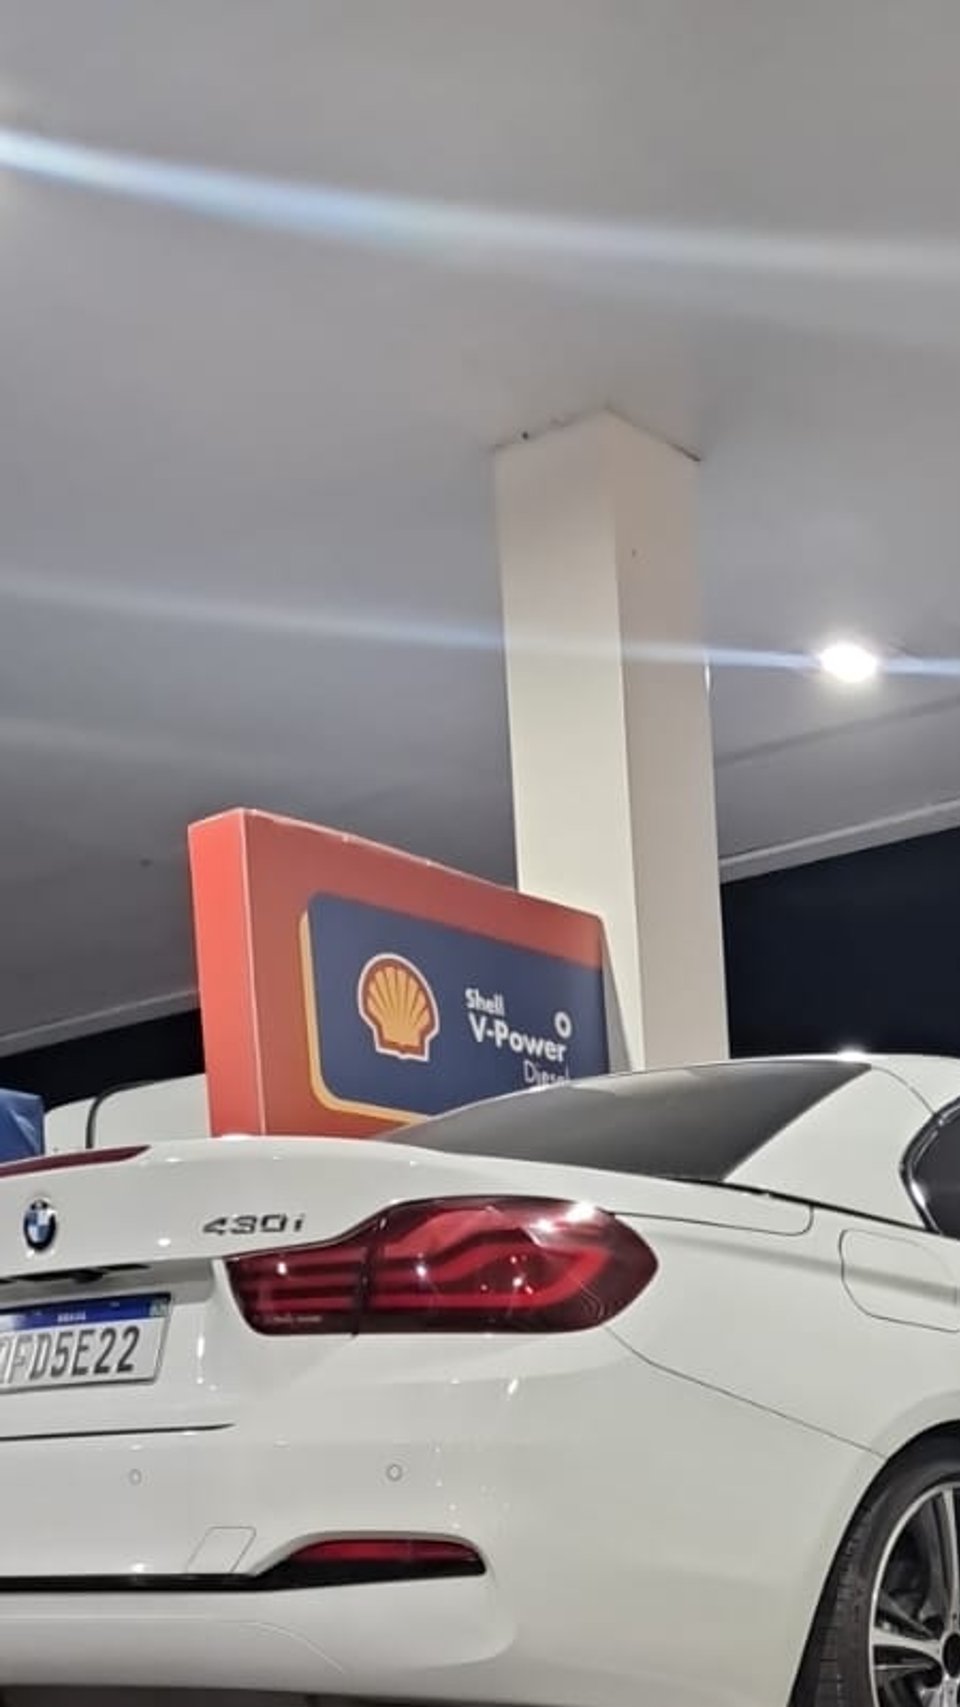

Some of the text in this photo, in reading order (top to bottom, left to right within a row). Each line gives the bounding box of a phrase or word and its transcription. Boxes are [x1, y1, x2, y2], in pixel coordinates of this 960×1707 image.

[464, 987, 505, 1016] Shell
[468, 1012, 567, 1062] V-Power
[203, 1213, 305, 1236] 430i
